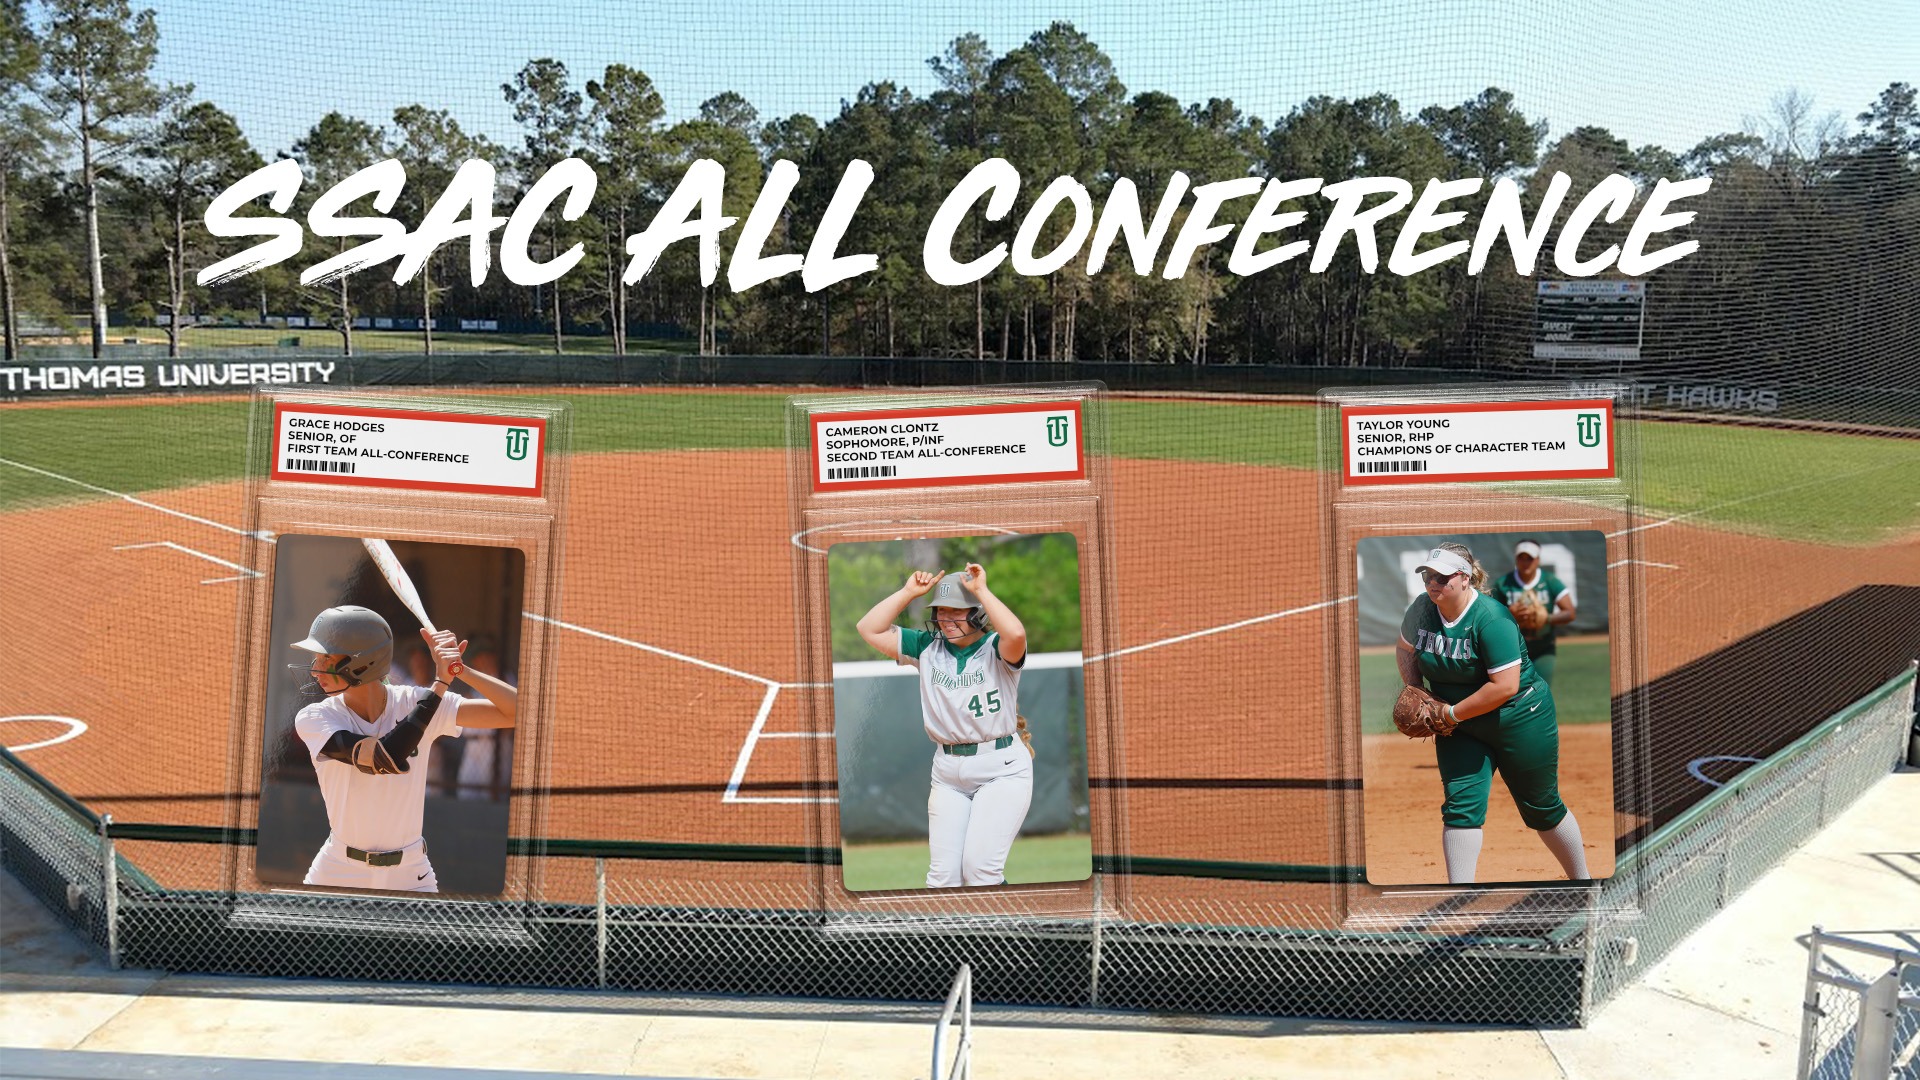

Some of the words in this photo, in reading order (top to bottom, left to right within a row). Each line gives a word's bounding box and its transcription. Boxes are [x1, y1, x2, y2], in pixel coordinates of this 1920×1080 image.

[0, 364, 146, 391] THOMAS
[157, 360, 336, 388] UNIVERSITY
[1666, 384, 1779, 412] HAWKS
[967, 688, 1002, 719] 45
